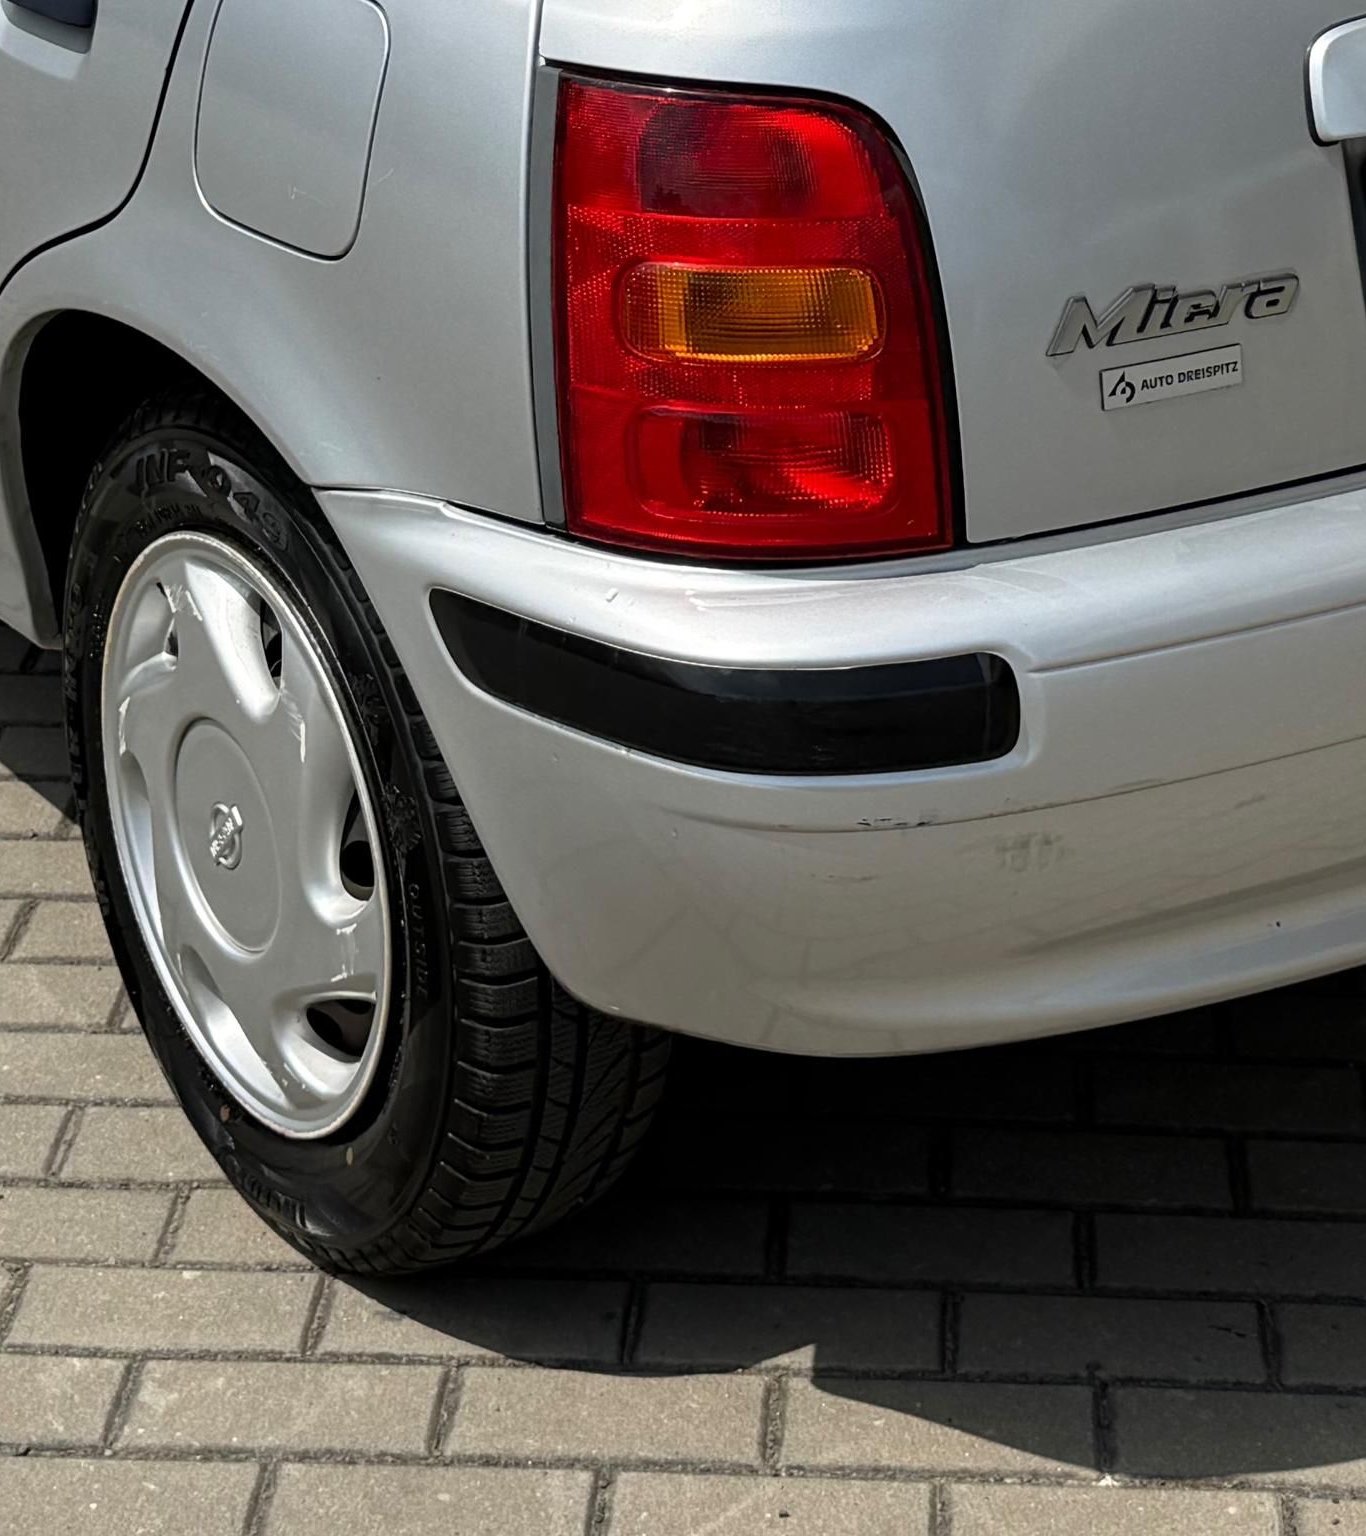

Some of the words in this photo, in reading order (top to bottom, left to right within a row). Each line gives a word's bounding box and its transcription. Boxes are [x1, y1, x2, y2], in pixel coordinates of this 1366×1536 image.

[1045, 271, 1300, 357] Micra
[1141, 374, 1174, 392] AUTO
[1178, 361, 1238, 383] DREISPITZ
